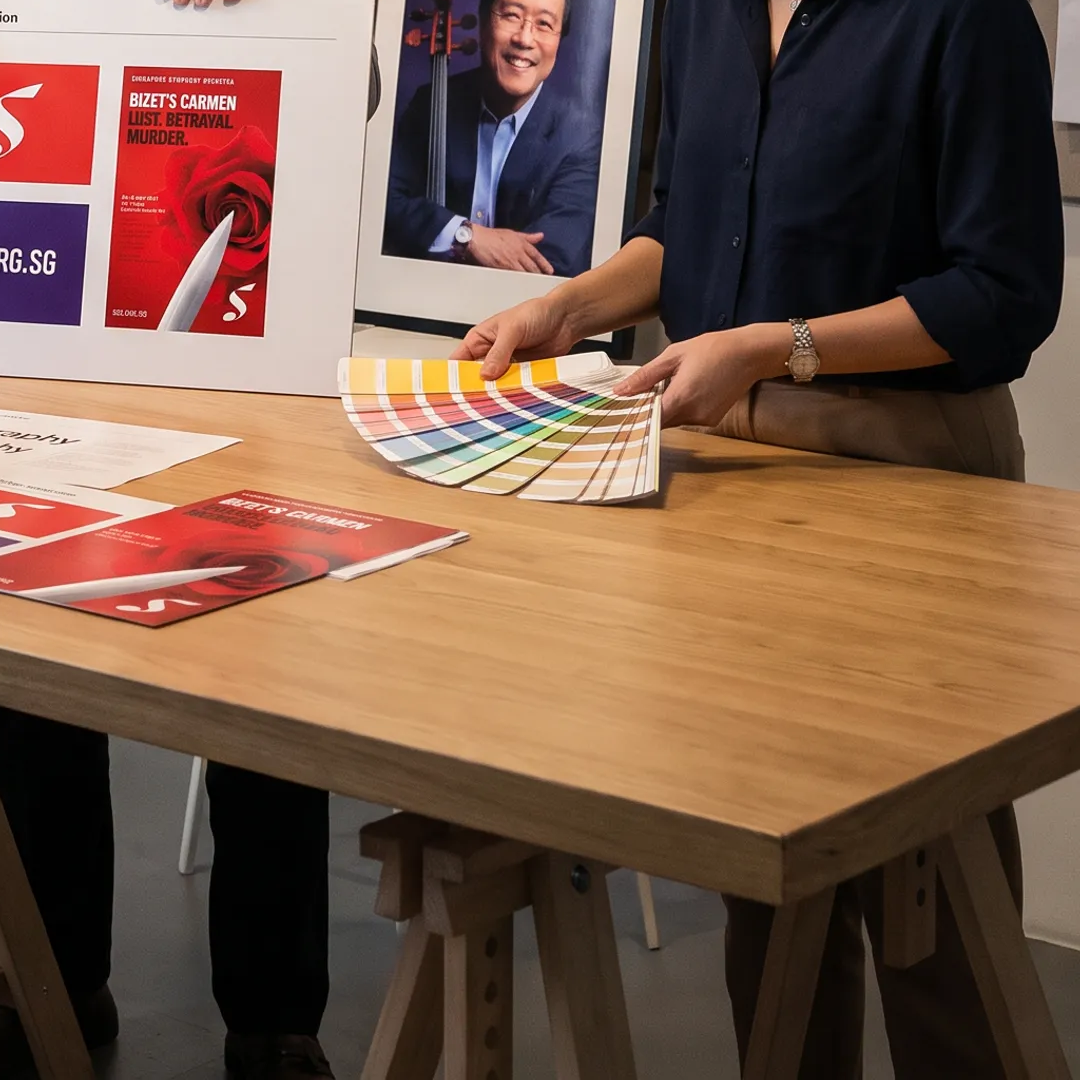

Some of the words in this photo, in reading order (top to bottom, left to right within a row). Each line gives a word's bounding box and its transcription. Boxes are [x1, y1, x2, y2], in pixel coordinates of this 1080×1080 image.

[129, 92, 177, 108] BIZET'S
[180, 94, 237, 111] CARMEN
[126, 129, 188, 146] MURDER.
